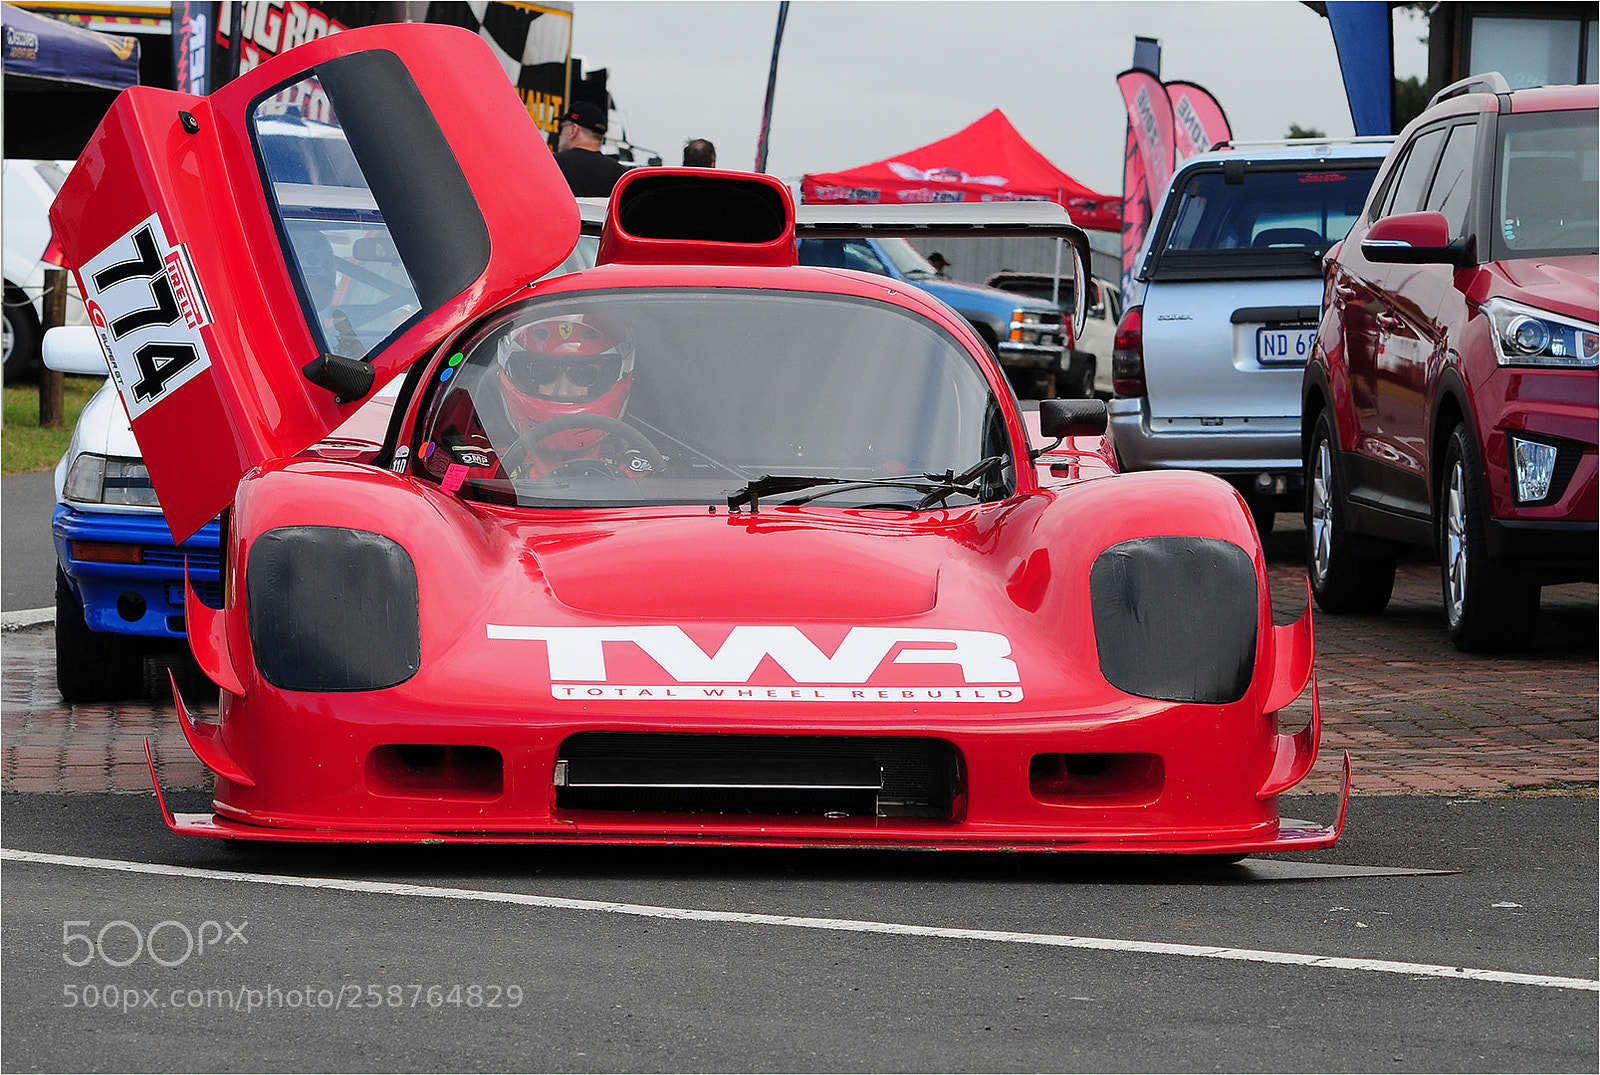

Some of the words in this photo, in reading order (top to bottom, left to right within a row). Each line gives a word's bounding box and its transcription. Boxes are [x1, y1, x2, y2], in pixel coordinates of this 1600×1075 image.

[92, 222, 200, 403] 774
[165, 250, 203, 330] PIRELLI
[1264, 333, 1288, 356] ND
[486, 624, 1022, 685] TWR
[562, 686, 678, 699] TOTAL
[702, 688, 826, 700] WHEEL
[851, 689, 1015, 701] REBUILD
